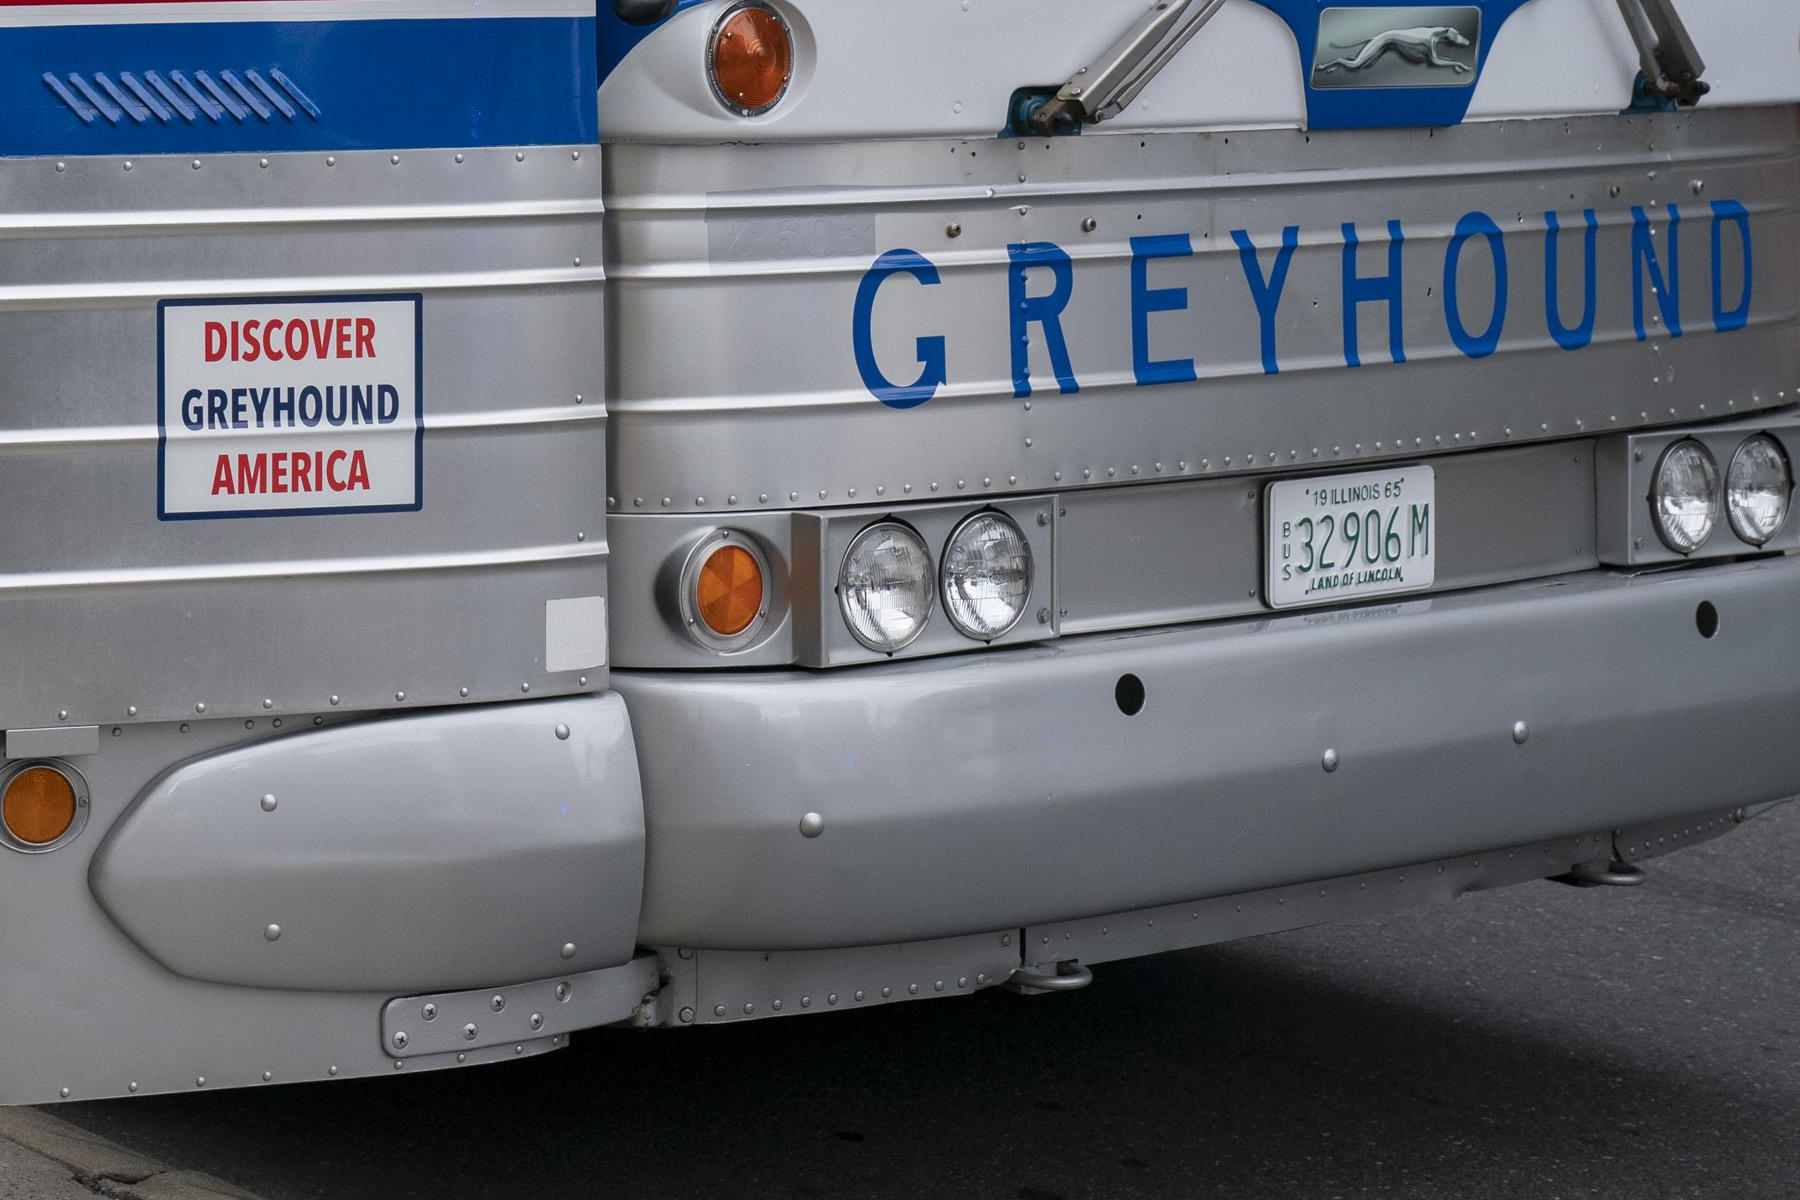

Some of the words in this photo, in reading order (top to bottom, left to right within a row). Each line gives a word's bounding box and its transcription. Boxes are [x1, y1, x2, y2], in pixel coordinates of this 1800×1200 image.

[852, 198, 1752, 409] GREYHOUND
[203, 316, 377, 363] DISCOVER
[180, 382, 400, 431] GREYHOUND
[210, 448, 371, 497] AMERICA
[1313, 490, 1327, 506] 19
[1331, 482, 1380, 506] ILLINOIS
[1384, 480, 1402, 499] 65
[1297, 505, 1402, 573] 32906
[1410, 502, 1430, 557] M
[1311, 573, 1339, 591] LAND
[1342, 571, 1355, 587] OF
[1358, 566, 1403, 584] LINCOLN
